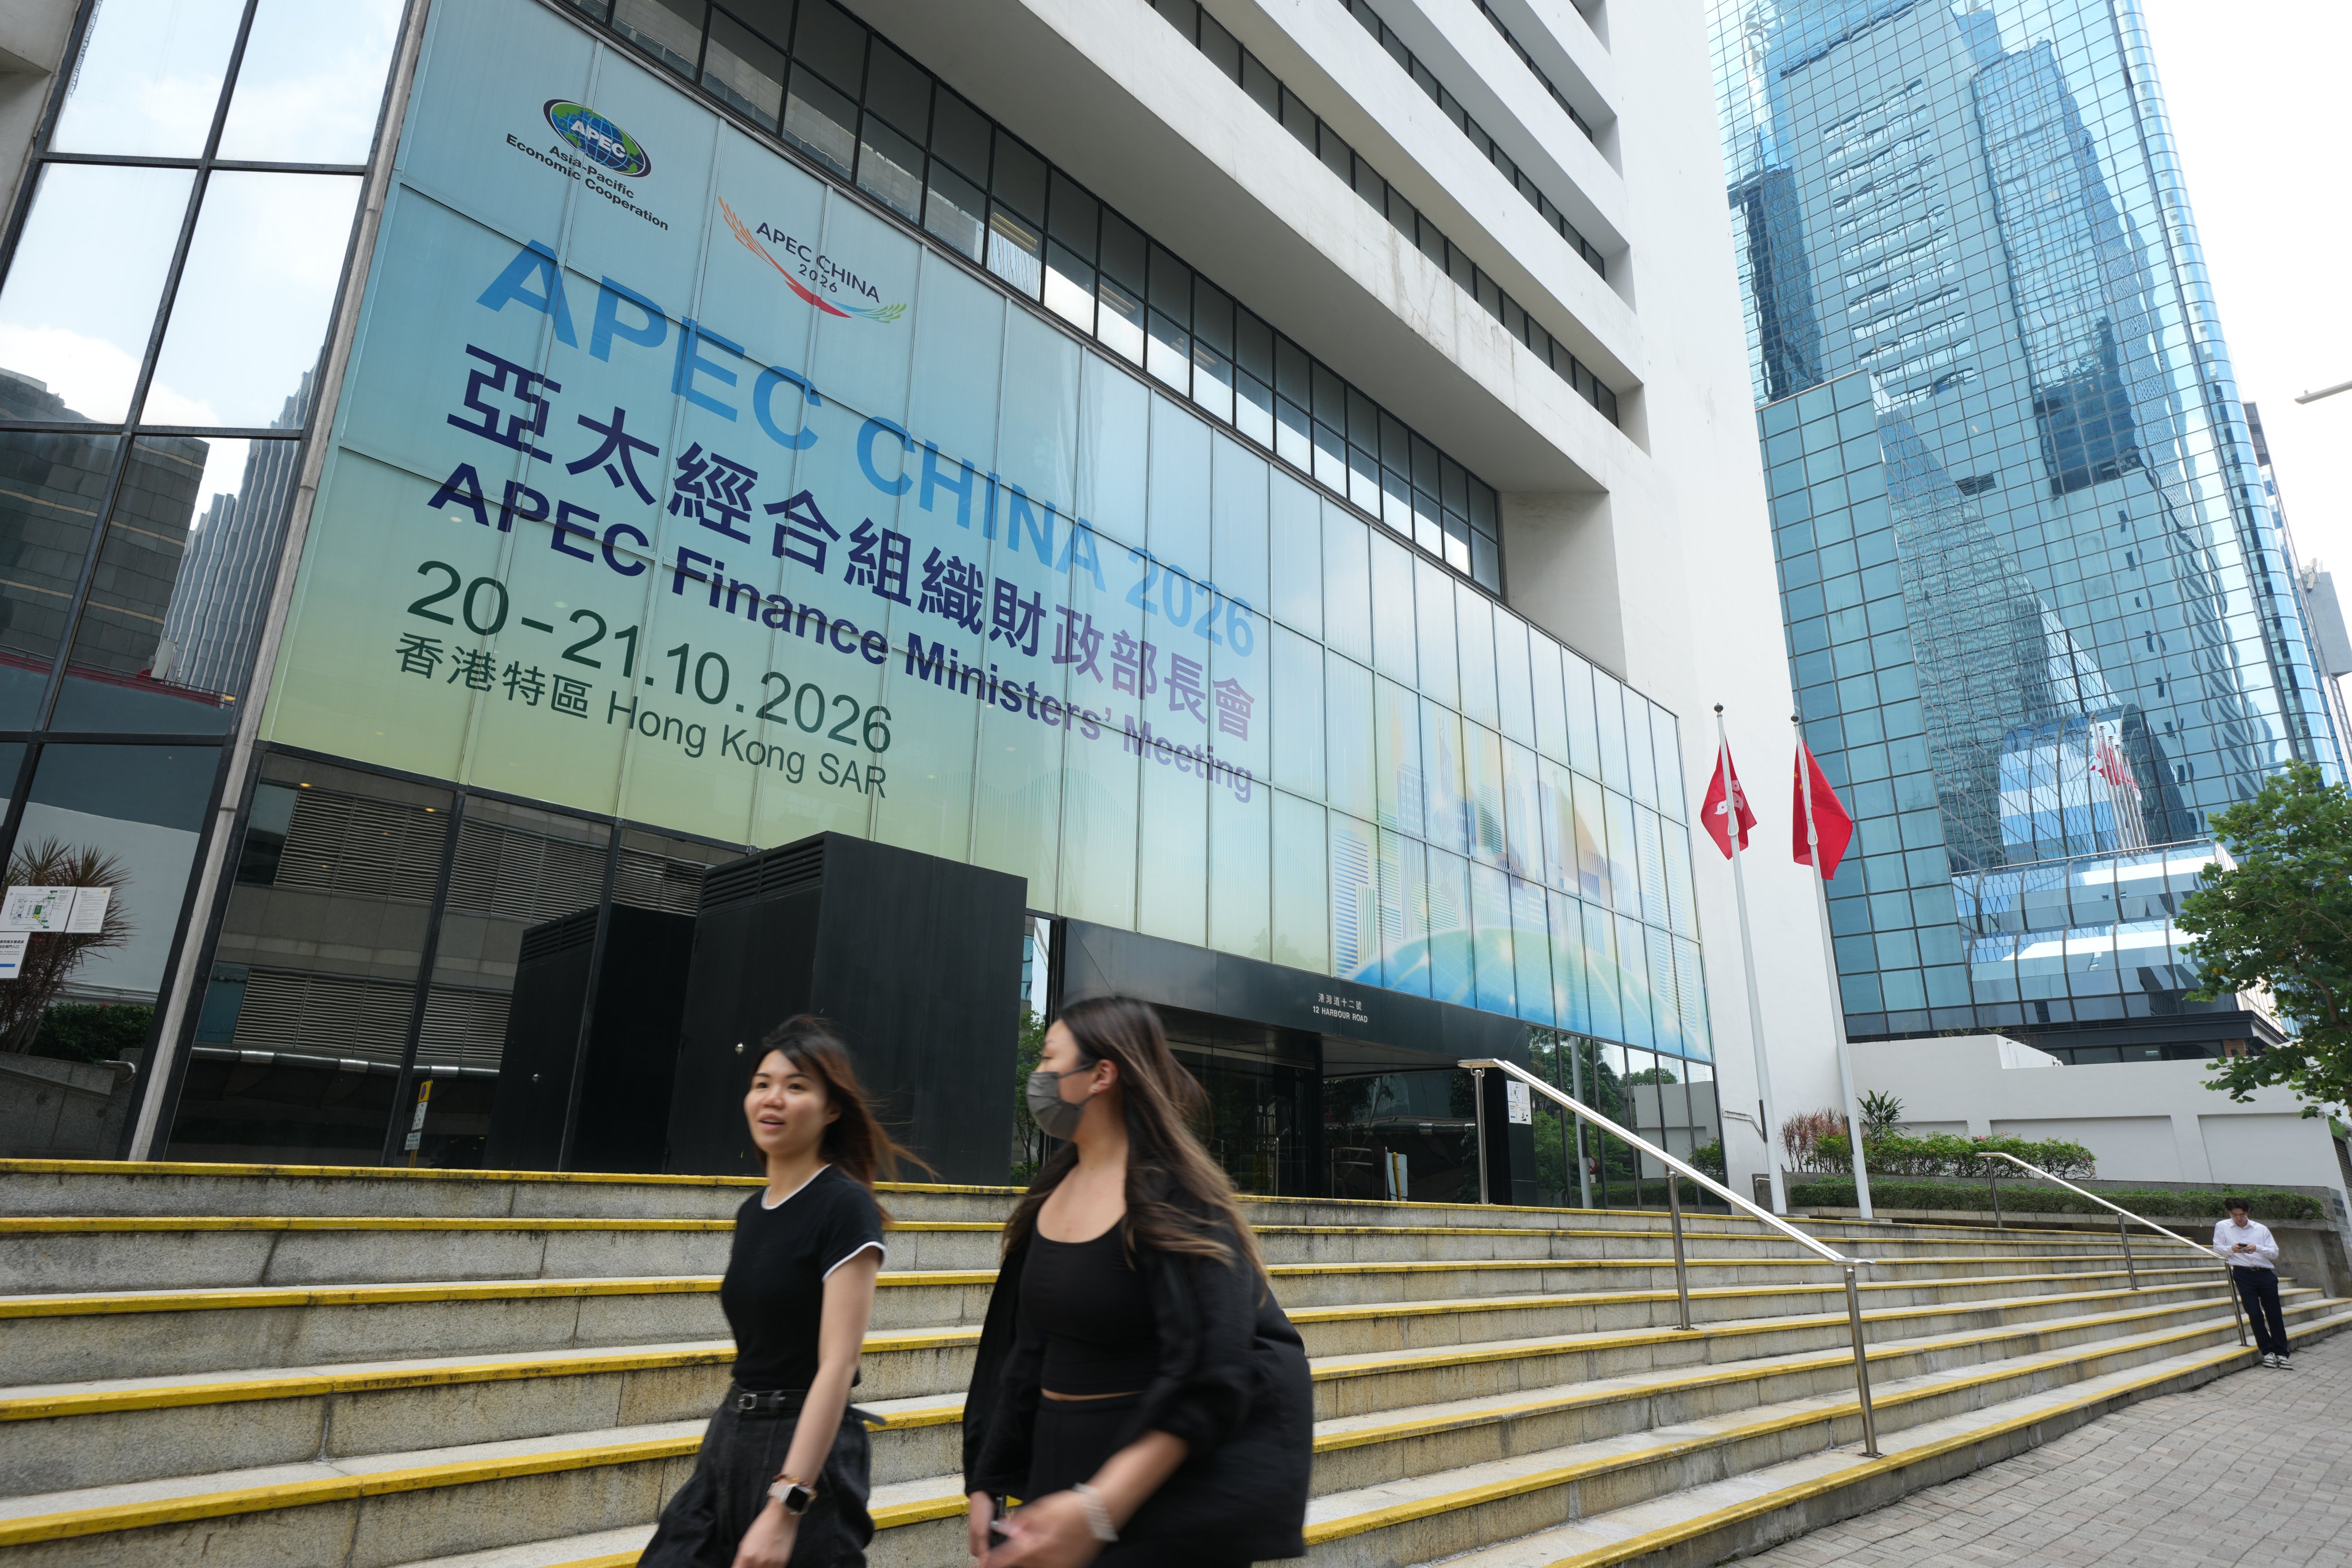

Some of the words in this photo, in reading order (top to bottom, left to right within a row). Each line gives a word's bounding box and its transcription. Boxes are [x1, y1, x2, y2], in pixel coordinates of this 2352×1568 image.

[549, 145, 635, 199] Asia-Pacific
[570, 118, 626, 159] APEC
[506, 133, 581, 180] Economic
[585, 179, 669, 231] Cooperation
[756, 222, 812, 262] APEC
[816, 256, 880, 304] CHINA
[798, 264, 837, 293] 2026
[476, 239, 822, 451] APEC
[856, 416, 1107, 593] CHINA
[1125, 547, 1254, 657] 2026
[447, 343, 1255, 741] 亞太經合組織財政部長會
[427, 462, 649, 576] APEC
[672, 546, 888, 665] Finance
[905, 632, 1111, 740] Ministers’
[1123, 715, 1252, 804] Meeting
[395, 632, 593, 719] 香港特區
[607, 690, 706, 758] Hong
[721, 724, 805, 783] Kong
[818, 752, 886, 798] SAR
[1318, 992, 1362, 1010] 港灣道十二號
[1322, 1007, 1350, 1019] HARBOUR
[1352, 1013, 1368, 1022] ROAD
